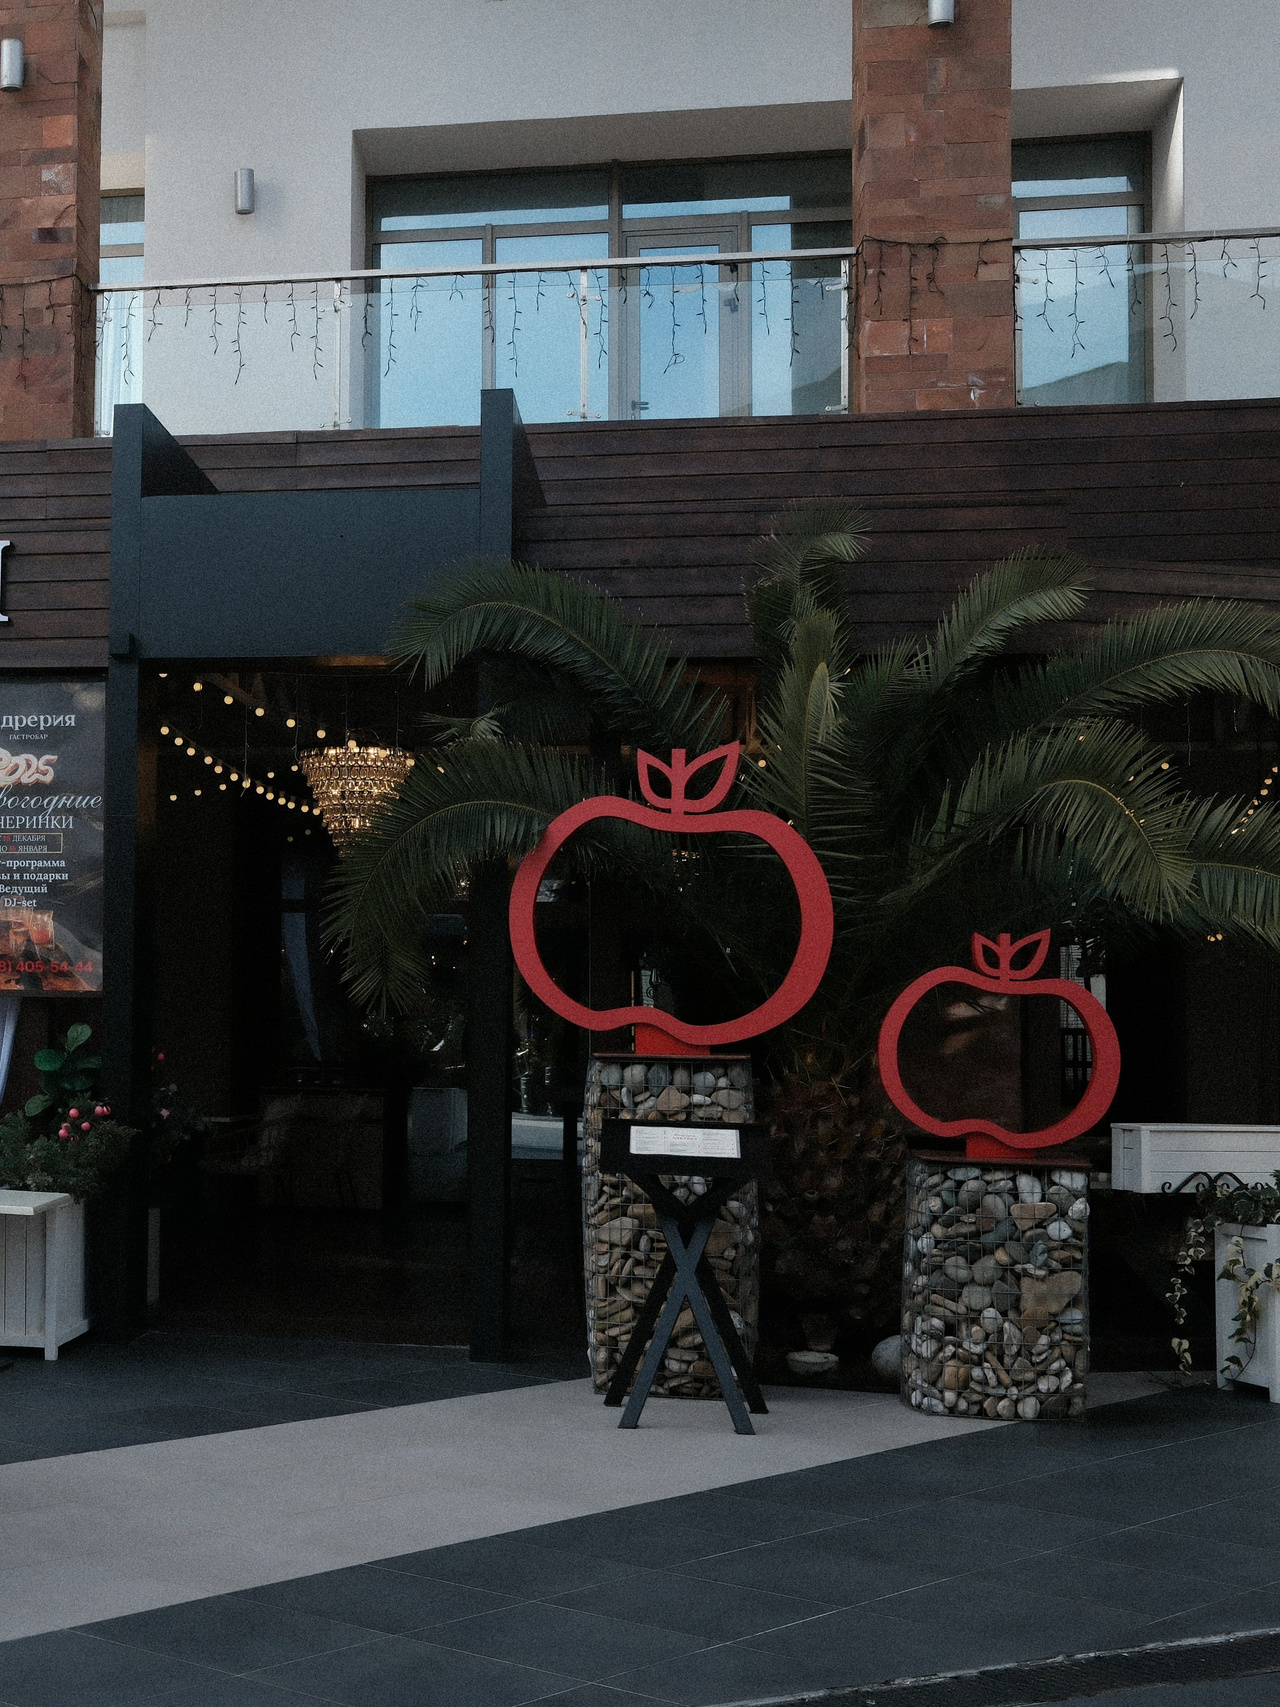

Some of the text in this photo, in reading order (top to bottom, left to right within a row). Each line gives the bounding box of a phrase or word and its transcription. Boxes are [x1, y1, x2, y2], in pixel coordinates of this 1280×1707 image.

[12, 835, 46, 843] ДЕКАБРЯ
[13, 872, 20, 880] и
[23, 872, 69, 882] подарки
[4, 898, 37, 908] DJ-set
[16, 960, 94, 973] 405-54-44
